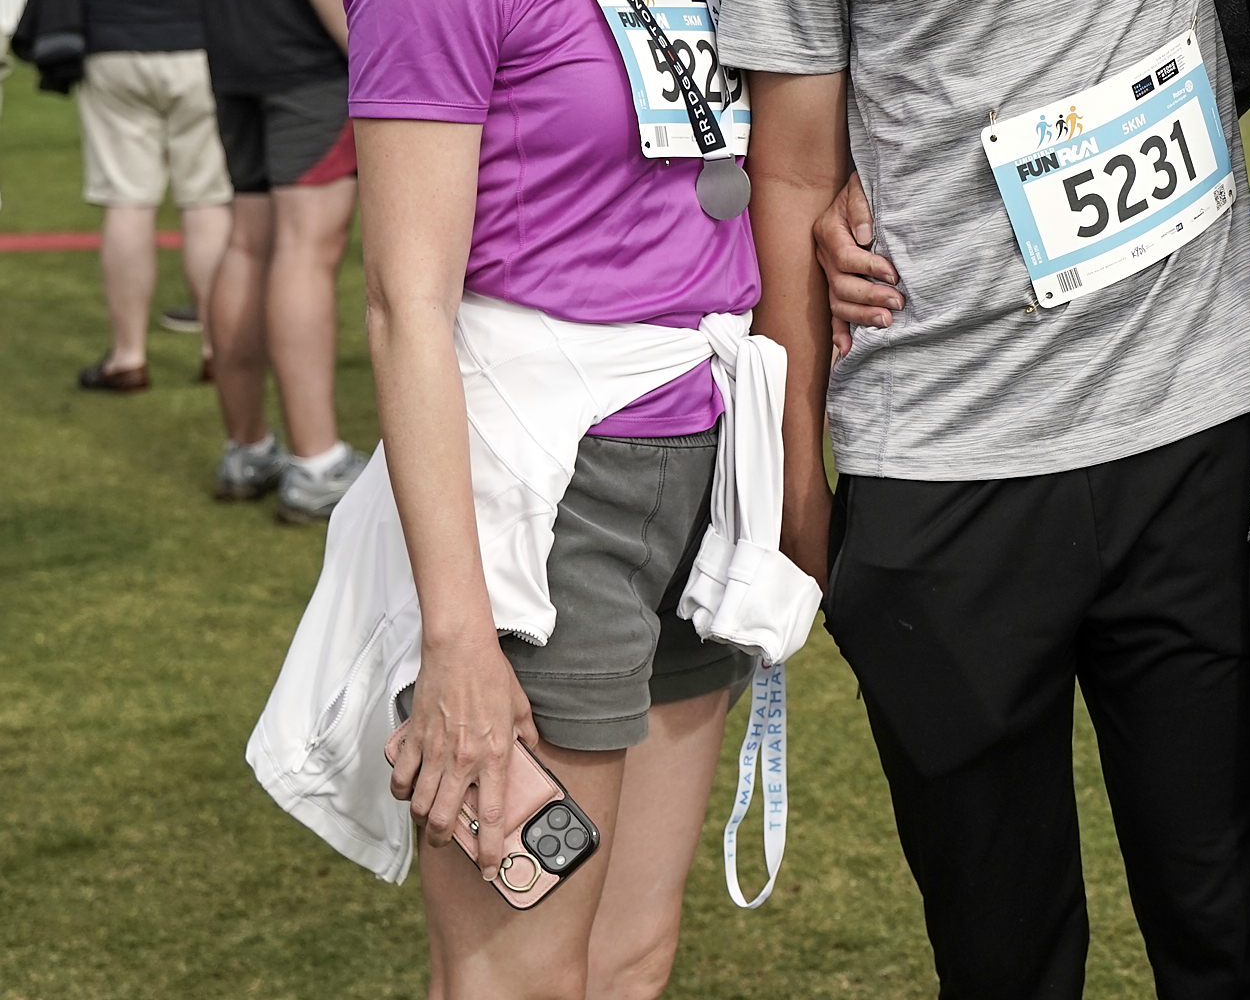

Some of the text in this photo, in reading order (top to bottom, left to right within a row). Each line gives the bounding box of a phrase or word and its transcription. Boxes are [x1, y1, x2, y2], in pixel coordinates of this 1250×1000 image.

[683, 15, 703, 27] 5KM
[673, 61, 717, 147] BRIDGE
[1121, 113, 1147, 135] 5KM
[1016, 136, 1100, 182] FUN RUN
[1062, 119, 1197, 238] 5231
[727, 814, 741, 859] THE
[739, 677, 770, 806] MARSHALL
[768, 663, 783, 830] THE MARSHA
